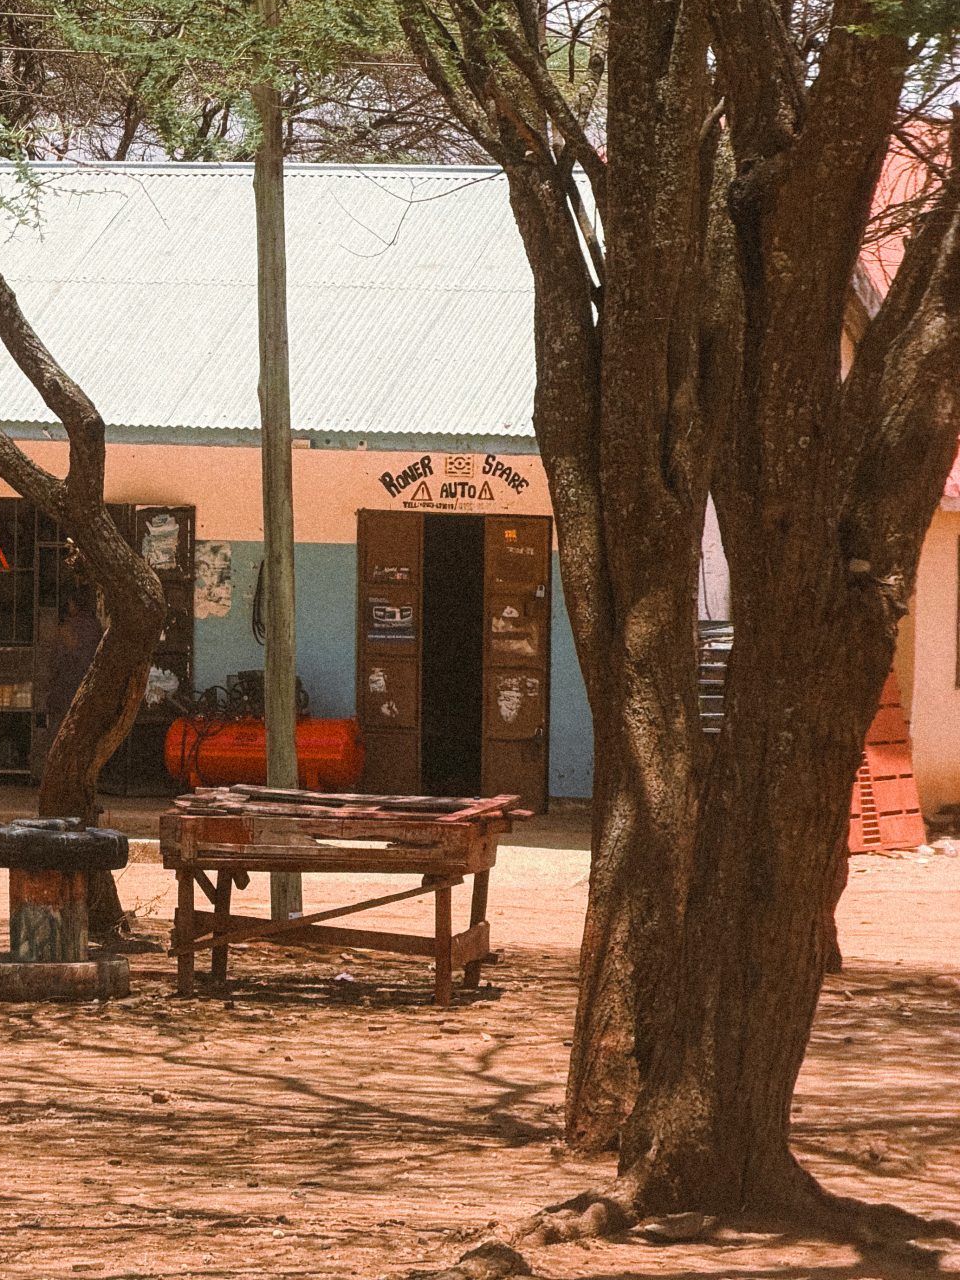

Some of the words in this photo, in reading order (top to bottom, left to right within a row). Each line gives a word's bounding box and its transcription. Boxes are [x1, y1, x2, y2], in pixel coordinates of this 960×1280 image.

[378, 455, 434, 498] RONER
[482, 454, 530, 495] SPARE
[440, 482, 477, 498] AUTO
